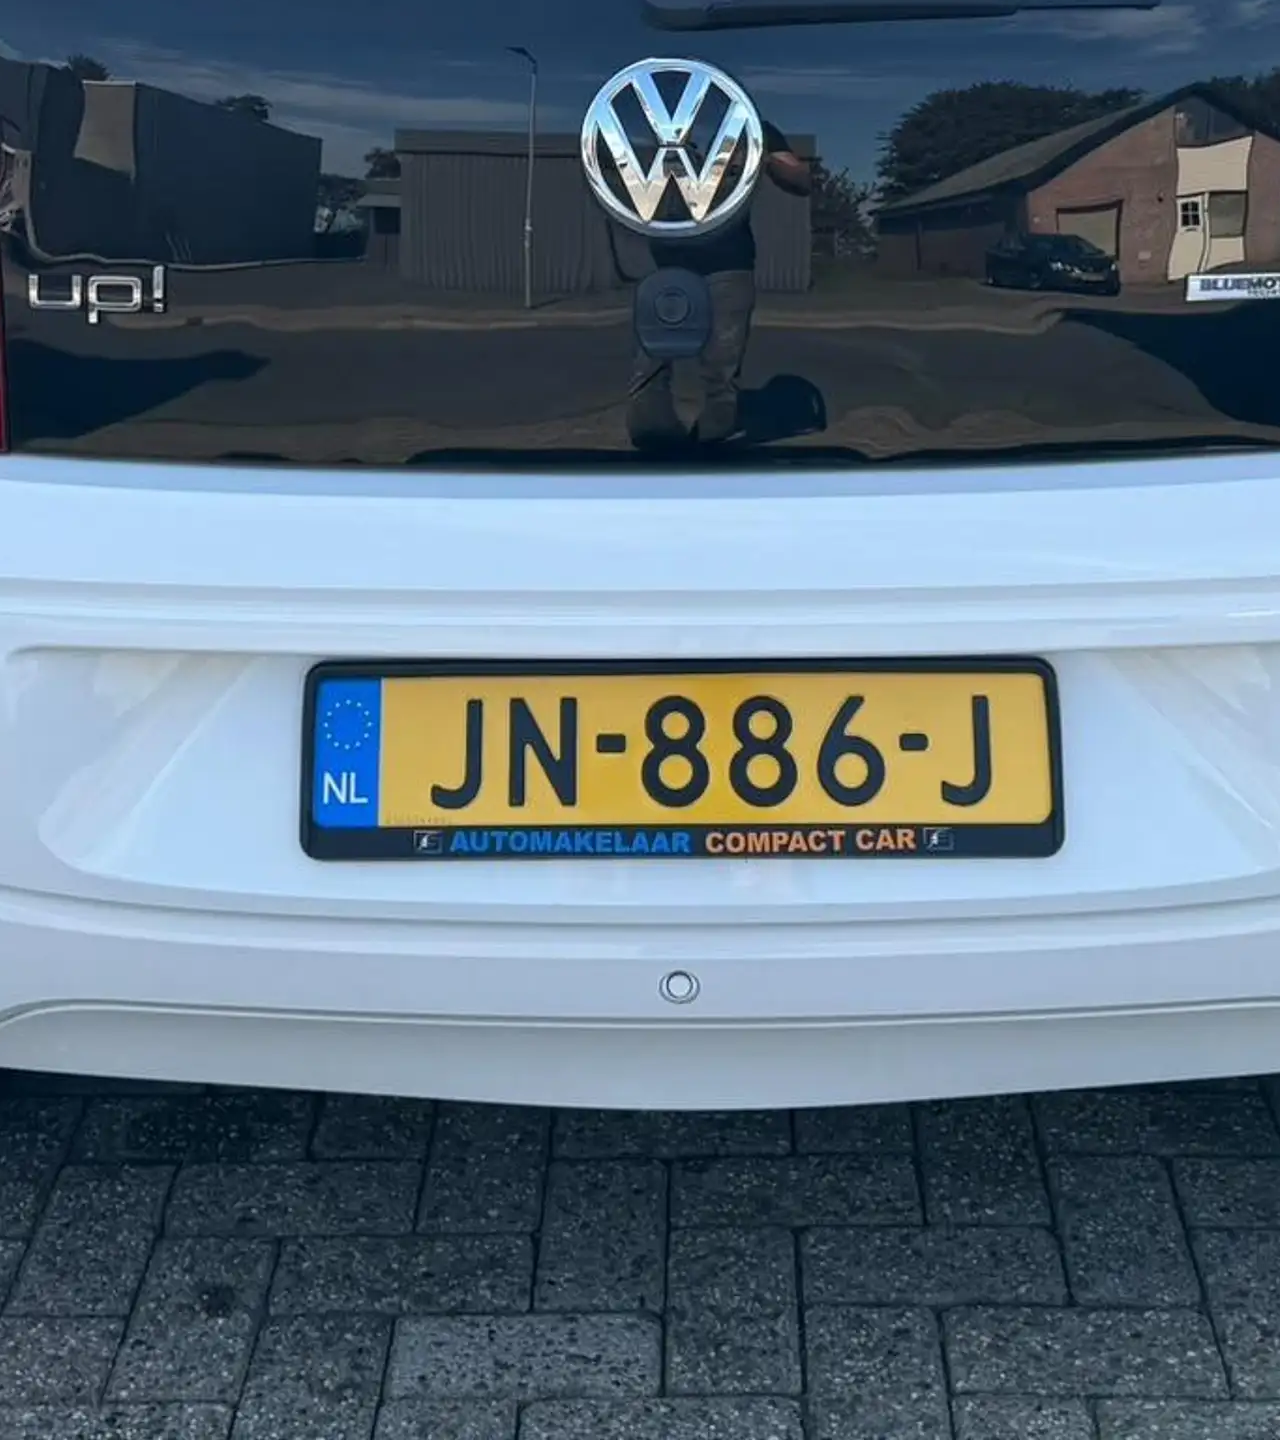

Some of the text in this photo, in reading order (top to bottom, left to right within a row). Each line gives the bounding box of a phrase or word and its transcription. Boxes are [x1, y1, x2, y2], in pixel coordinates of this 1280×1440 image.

[27, 263, 166, 324] up!
[430, 694, 993, 811] JN-886-J
[322, 771, 369, 805] NL
[449, 825, 917, 856] AUTOMAKELAAR COMPACT CAR
